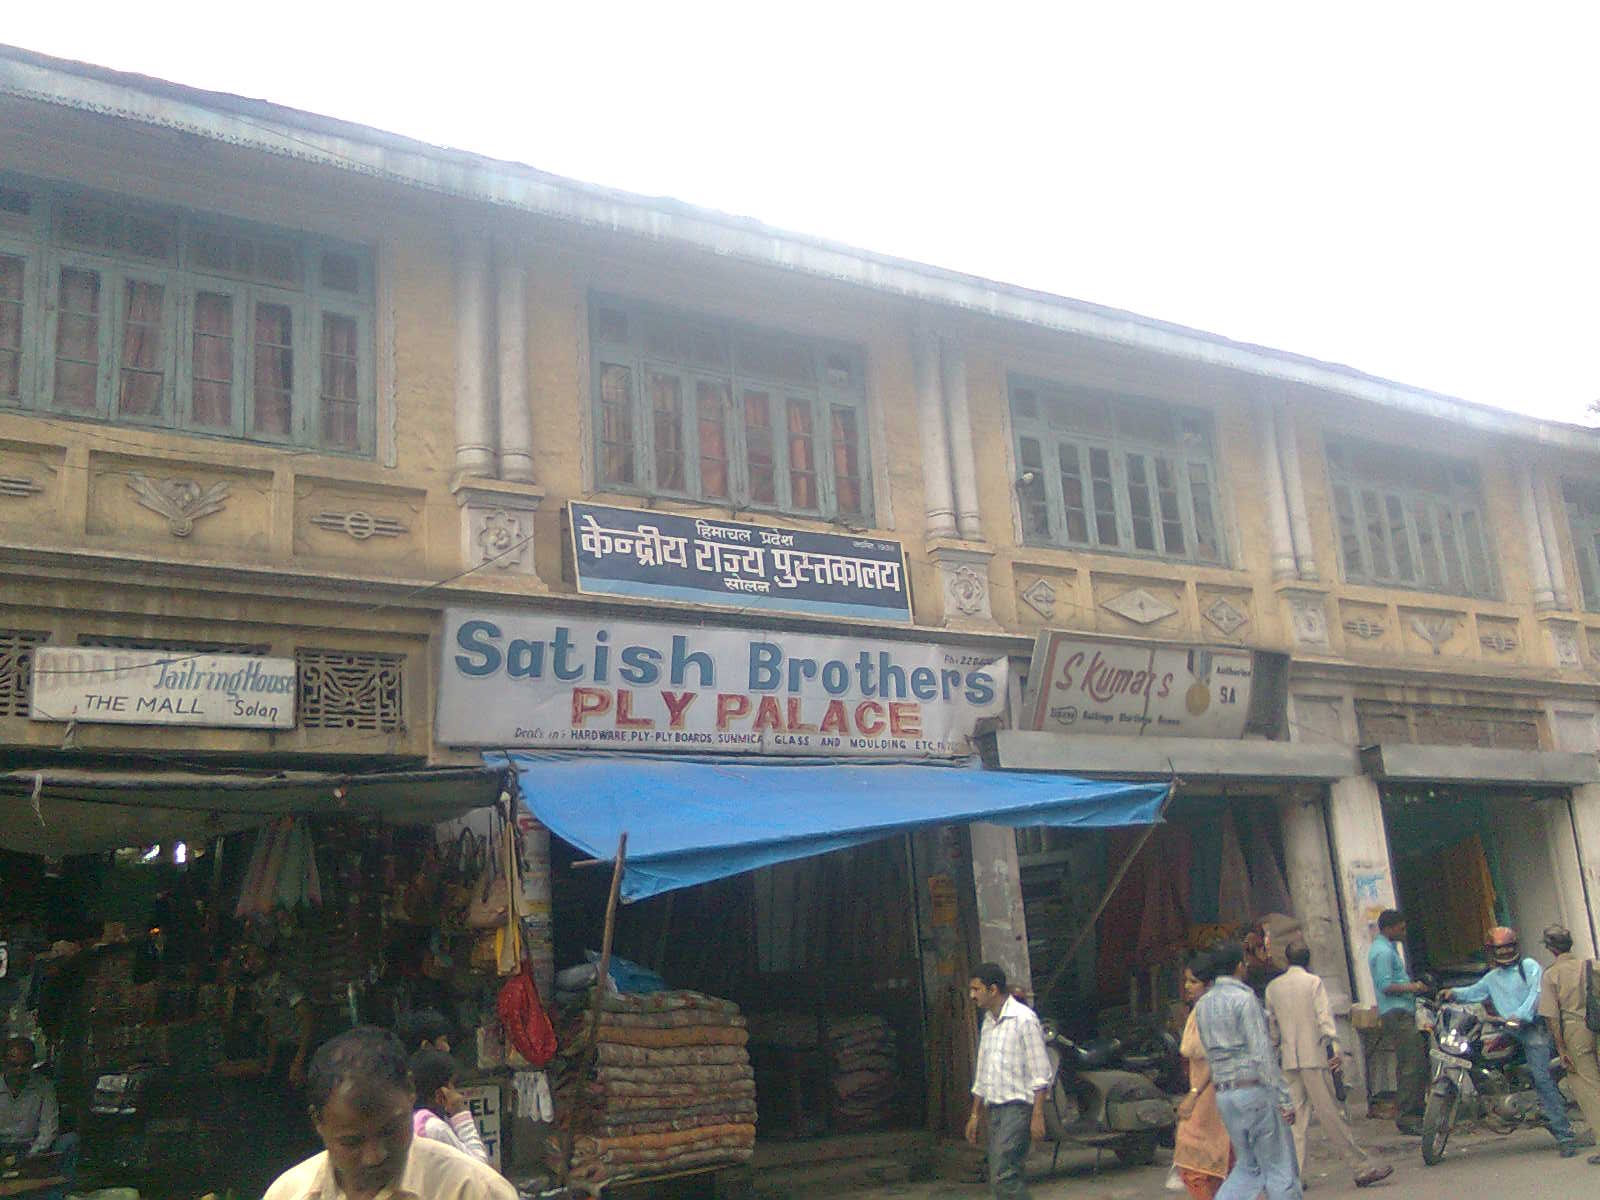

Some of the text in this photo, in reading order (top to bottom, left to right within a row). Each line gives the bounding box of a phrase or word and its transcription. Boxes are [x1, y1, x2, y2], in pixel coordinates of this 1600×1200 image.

[696, 519, 795, 547] हिमाचल प्रदेश
[580, 514, 901, 592] केन्द्रीय राज्य पुस्तकालय
[723, 572, 771, 593] सोलन
[454, 619, 994, 705] Satish Brothers
[85, 694, 205, 715] THE MALL
[233, 700, 279, 721] Solan
[571, 687, 923, 739] PLY PALACE
[774, 735, 810, 746] GLASS
[820, 737, 841, 747] AND
[850, 739, 907, 750] MOULDING
